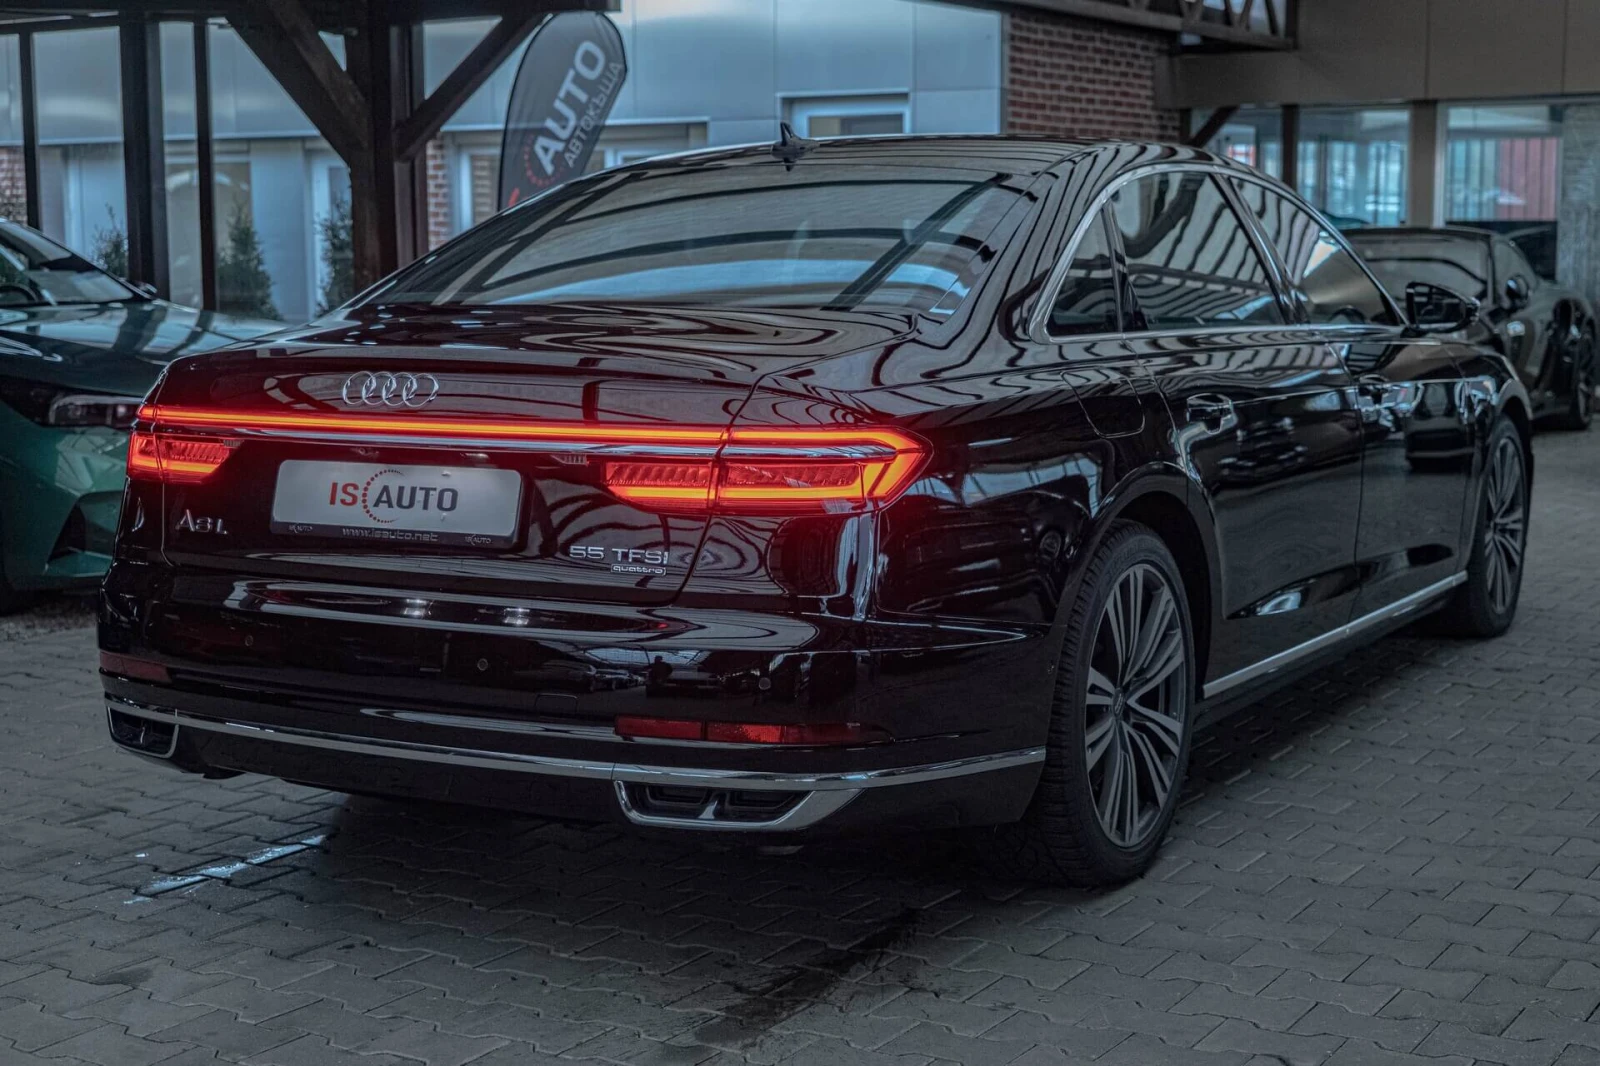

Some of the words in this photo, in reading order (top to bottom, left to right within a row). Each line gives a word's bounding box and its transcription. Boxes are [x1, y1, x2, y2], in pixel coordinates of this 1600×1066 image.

[533, 40, 605, 176] AUTO
[328, 482, 359, 507] IS
[373, 484, 459, 512] AUTO
[342, 527, 439, 542] www.isauto.net
[569, 545, 605, 560] 55
[611, 548, 669, 566] TFSI
[612, 565, 664, 575] quattro
